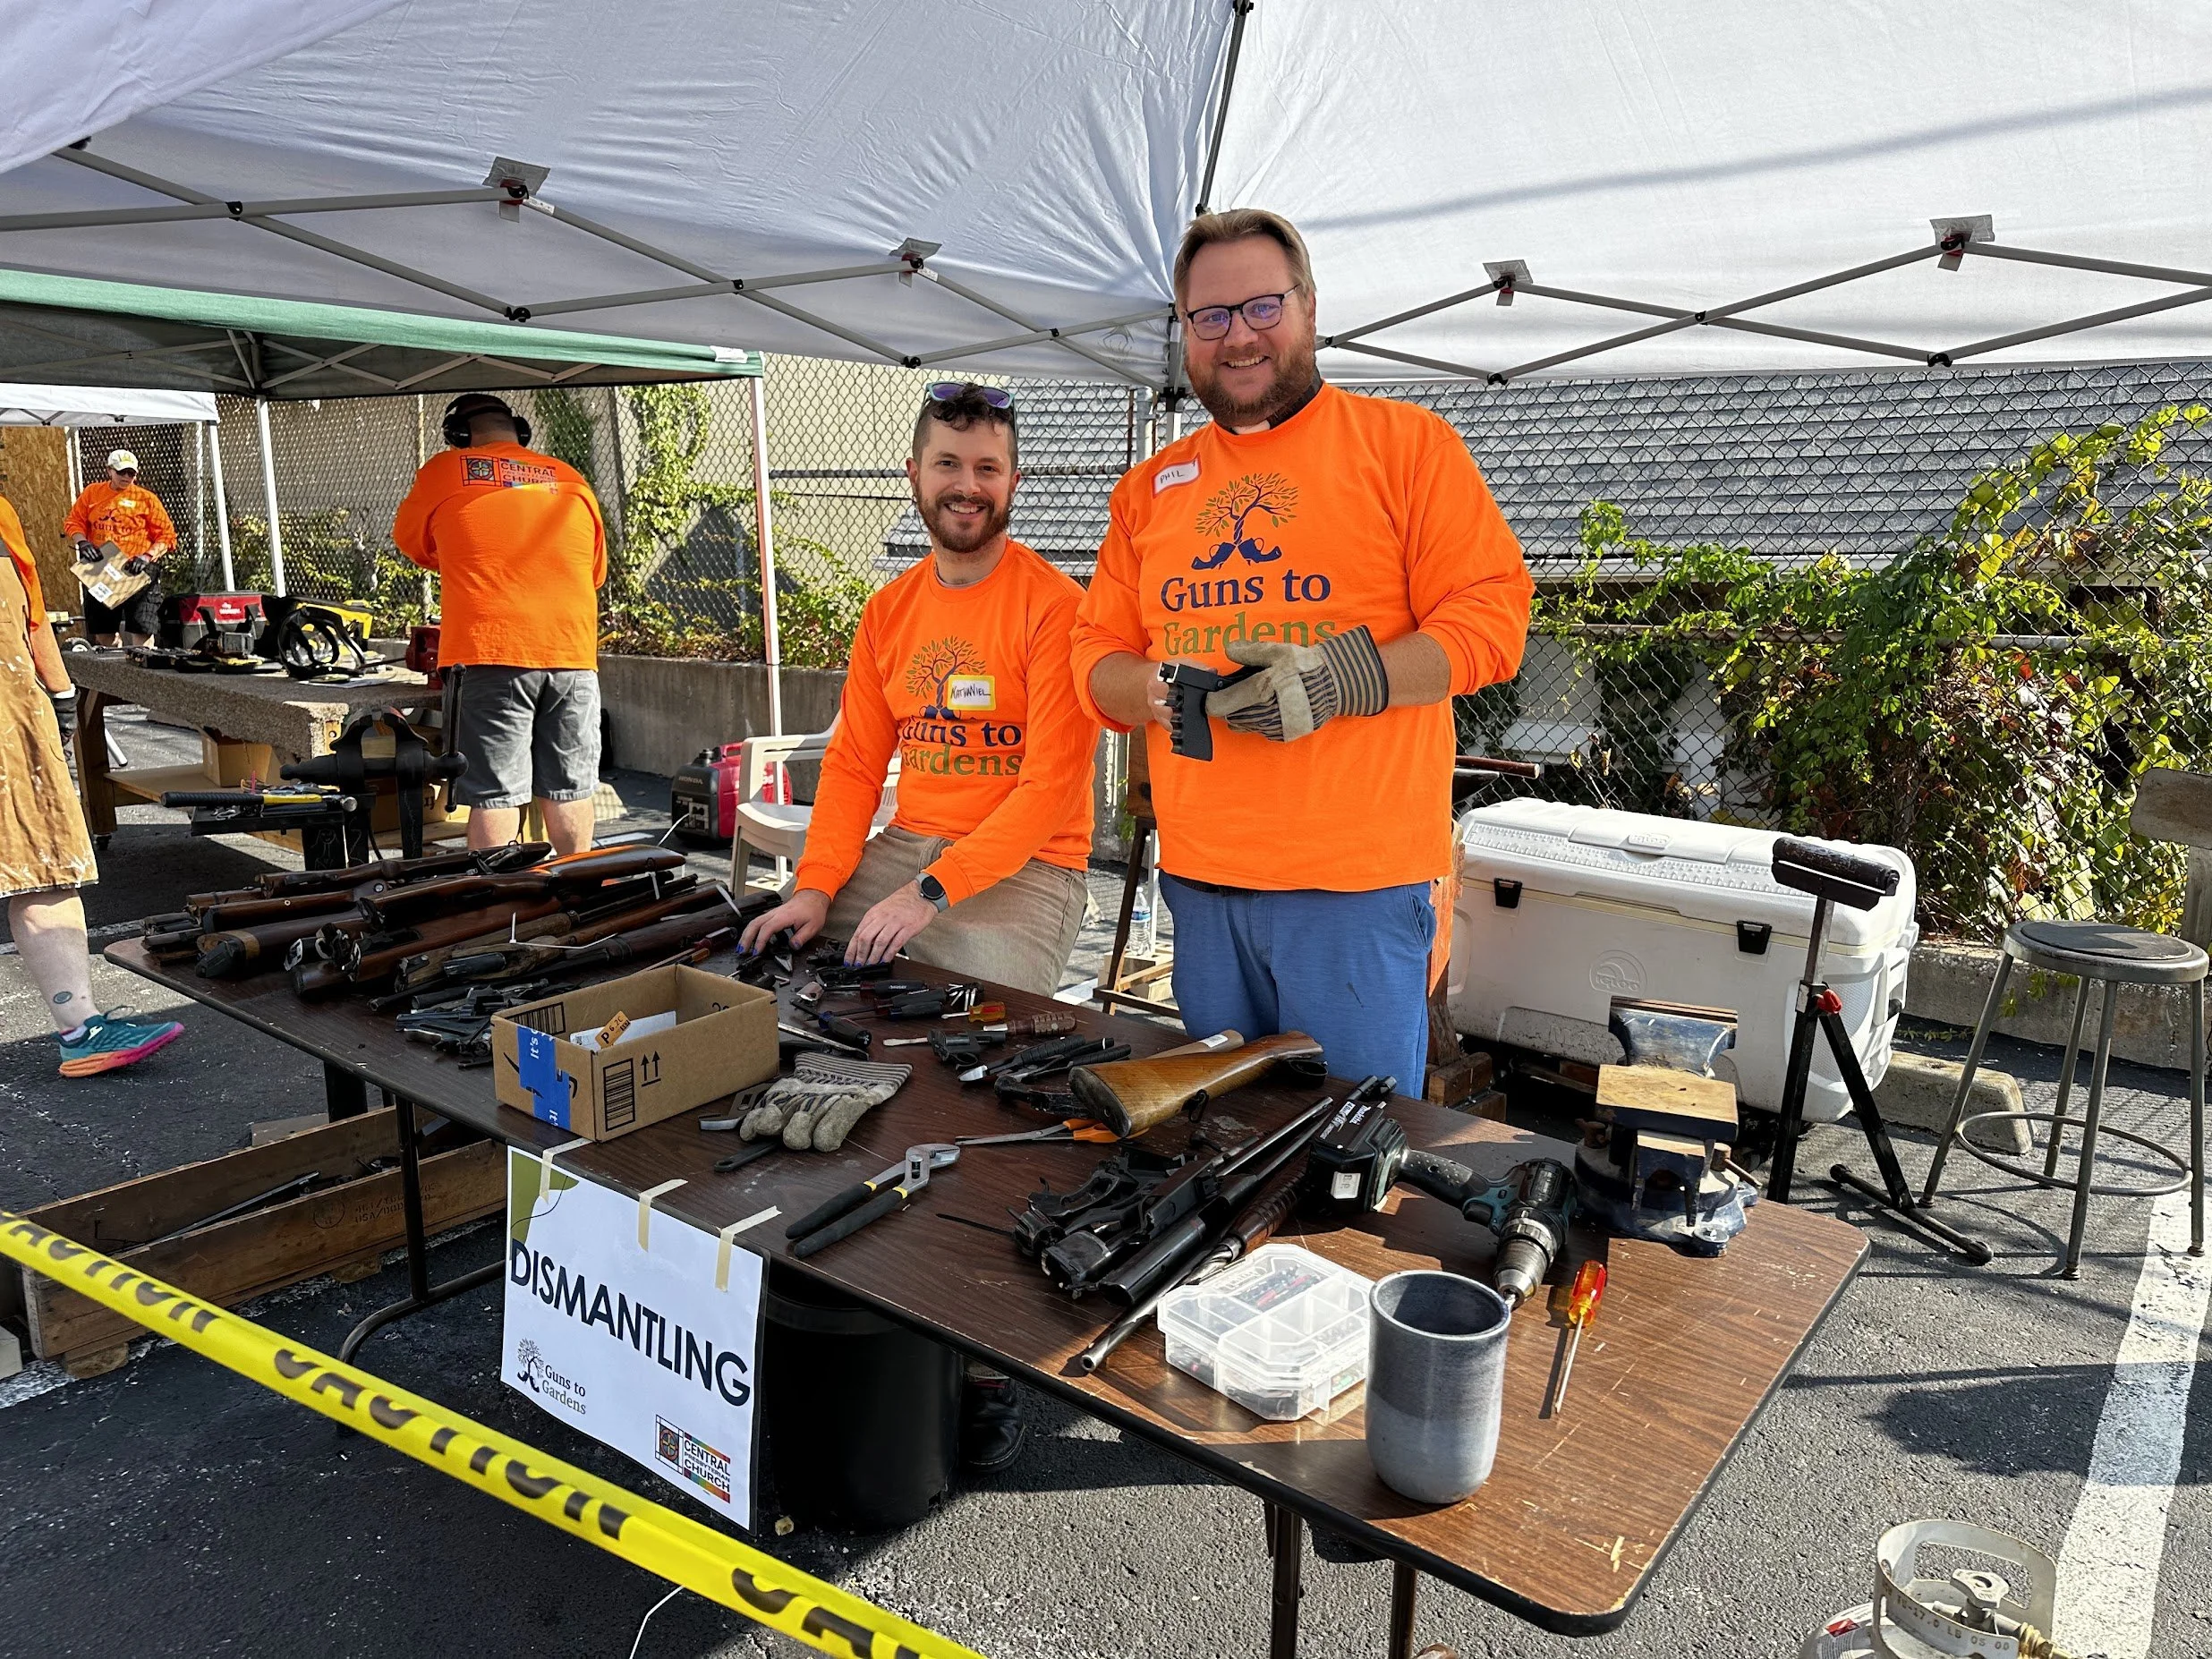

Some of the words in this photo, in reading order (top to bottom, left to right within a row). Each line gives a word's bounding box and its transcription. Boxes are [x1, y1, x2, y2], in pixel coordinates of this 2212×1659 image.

[500, 462, 556, 477] CENTRAL
[1160, 470, 1185, 484] PHIL
[1161, 575, 1263, 612] Guns
[1282, 569, 1331, 602] to
[902, 716, 966, 747] Guns
[981, 721, 1022, 747] to
[900, 744, 1023, 776] Gardens
[678, 775, 703, 785] HONDA
[600, 1032, 610, 1044] P
[510, 1238, 751, 1407] DISMANTLING
[541, 1379, 586, 1415] Gardens
[545, 1365, 571, 1390] Guns
[574, 1382, 586, 1398] to
[684, 1439, 731, 1476] CENTRAL
[684, 1459, 730, 1493] CHURCH
[1946, 1626, 1962, 1639] LB
